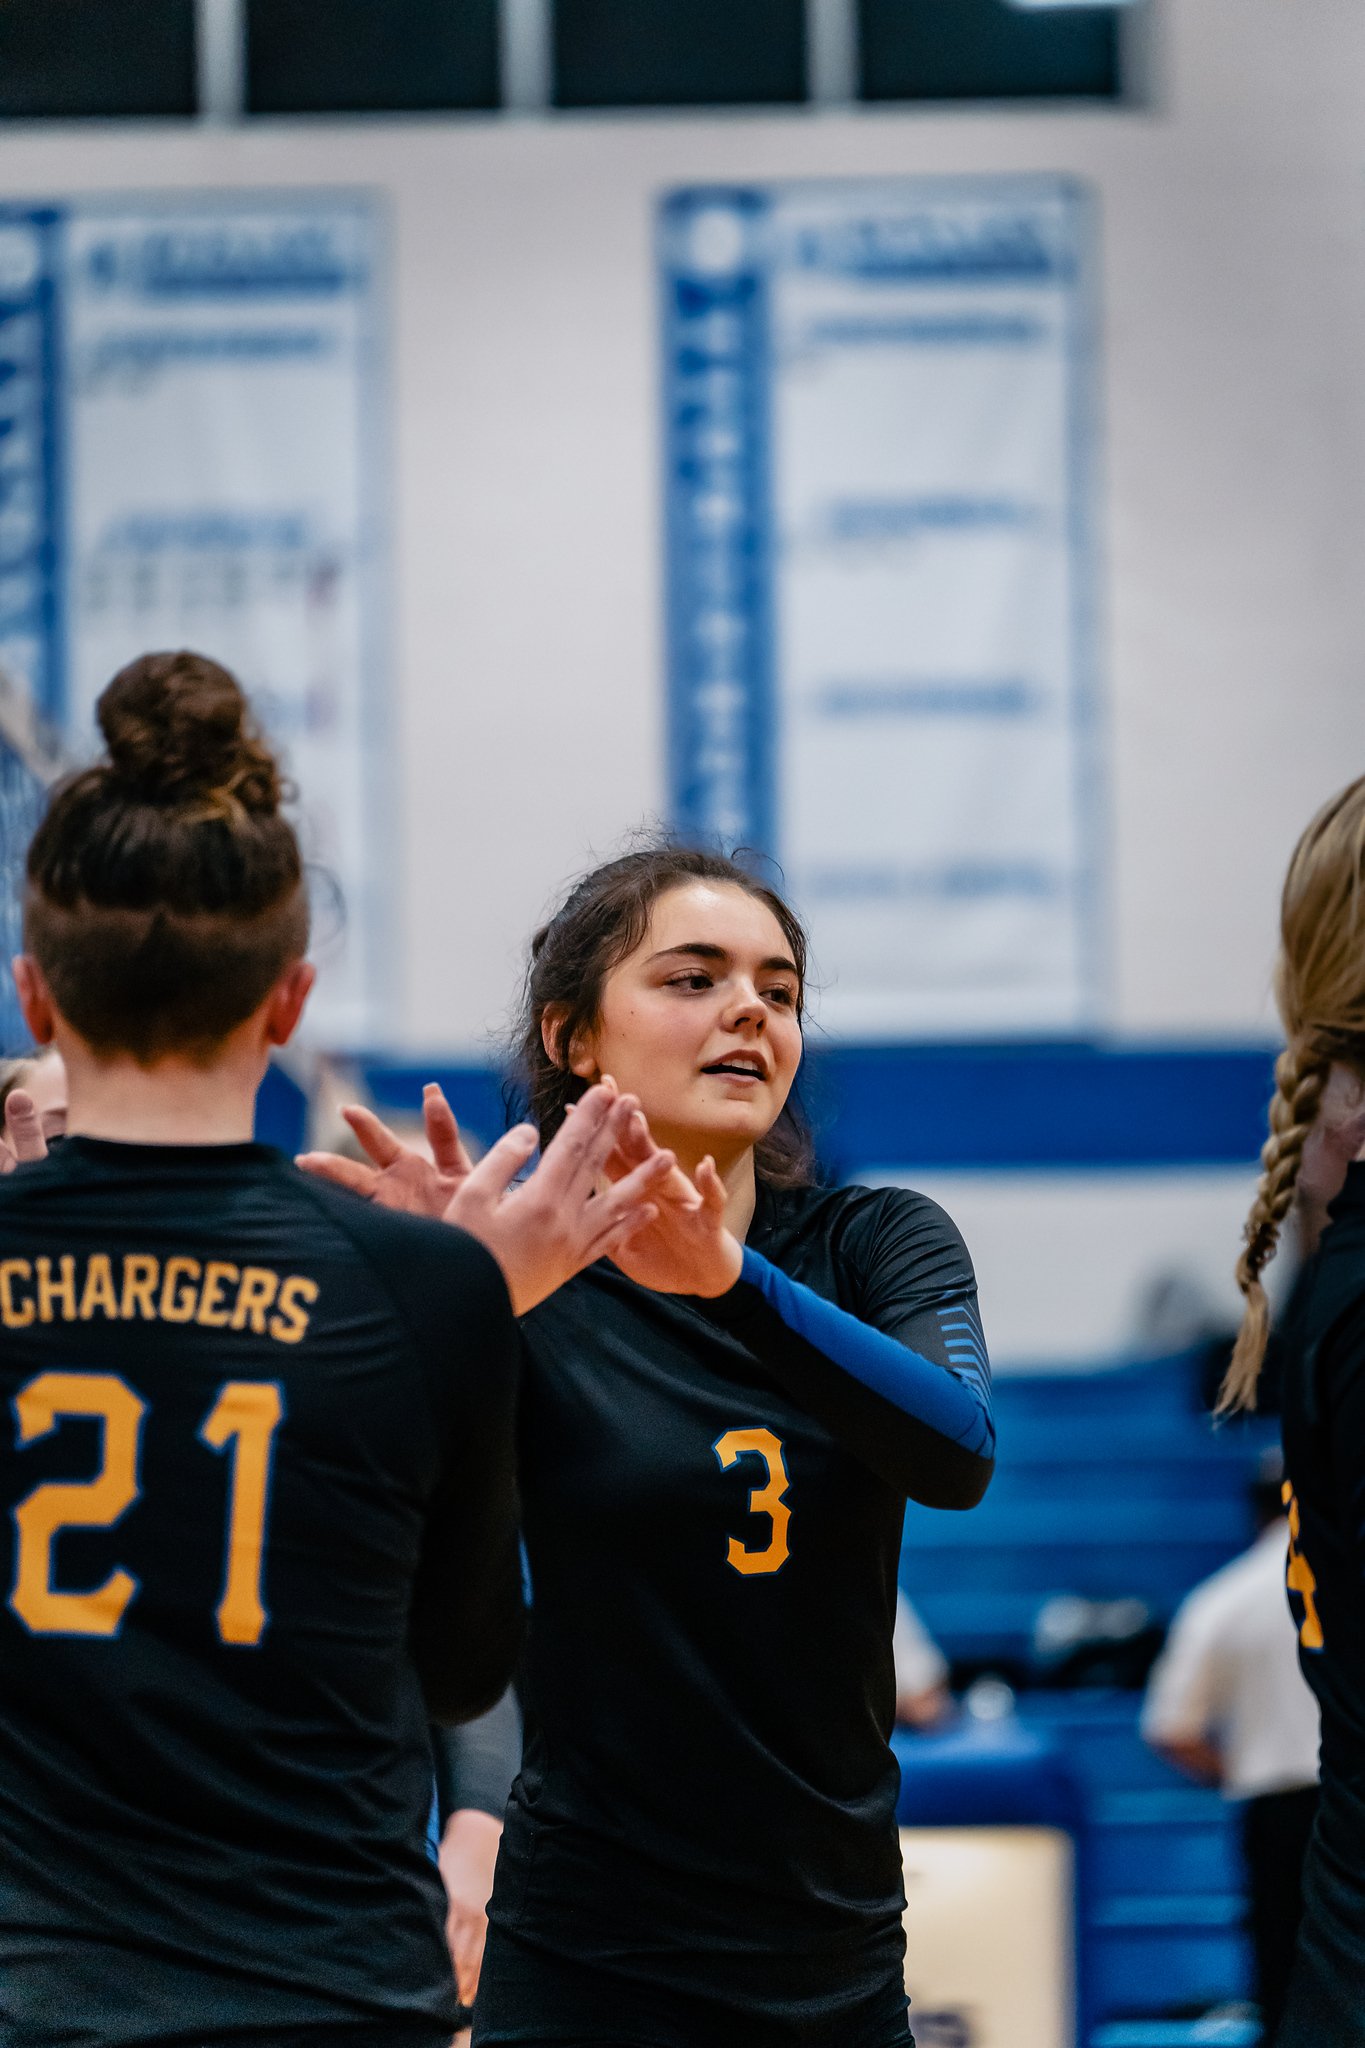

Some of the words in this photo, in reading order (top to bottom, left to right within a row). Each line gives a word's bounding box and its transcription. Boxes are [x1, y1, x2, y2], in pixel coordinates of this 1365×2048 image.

[0, 1254, 320, 1344] CHARGERS
[9, 1370, 285, 1647] 21
[711, 1424, 794, 1577] 3
